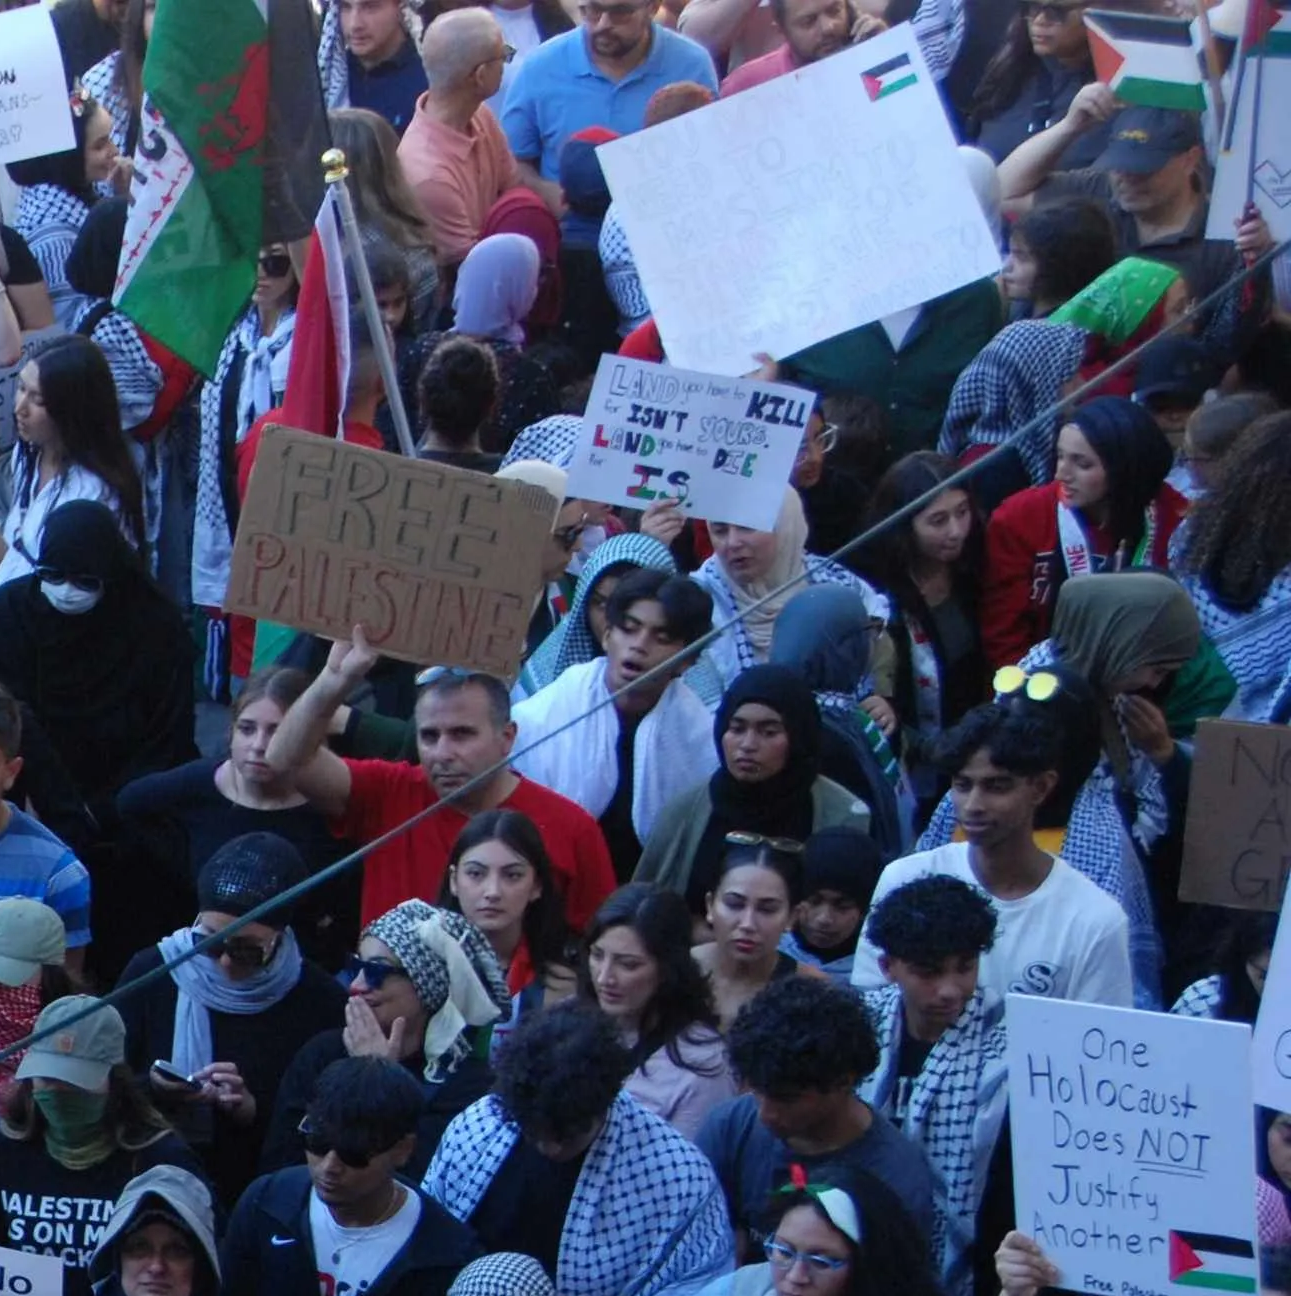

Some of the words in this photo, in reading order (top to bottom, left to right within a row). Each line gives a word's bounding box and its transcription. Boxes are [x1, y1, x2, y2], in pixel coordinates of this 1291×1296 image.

[610, 364, 680, 403] LAND
[682, 382, 704, 405] you
[734, 386, 746, 399] to
[745, 391, 807, 428] KILL
[627, 404, 688, 432] ISN'T
[592, 424, 656, 457] LAND
[712, 448, 757, 478] DIE
[274, 440, 502, 578] FREE
[239, 531, 523, 674] PALESTINE
[1082, 1028, 1149, 1068] One
[1028, 1053, 1197, 1118] Holocaust
[1053, 1110, 1124, 1155] Does
[1137, 1129, 1210, 1171] NOT
[1, 1190, 117, 1222] ALESTIN
[1048, 1164, 1158, 1221] Justify
[33, 1221, 73, 1245] ON
[1032, 1211, 1165, 1255] Another
[1084, 1274, 1113, 1292] Free
